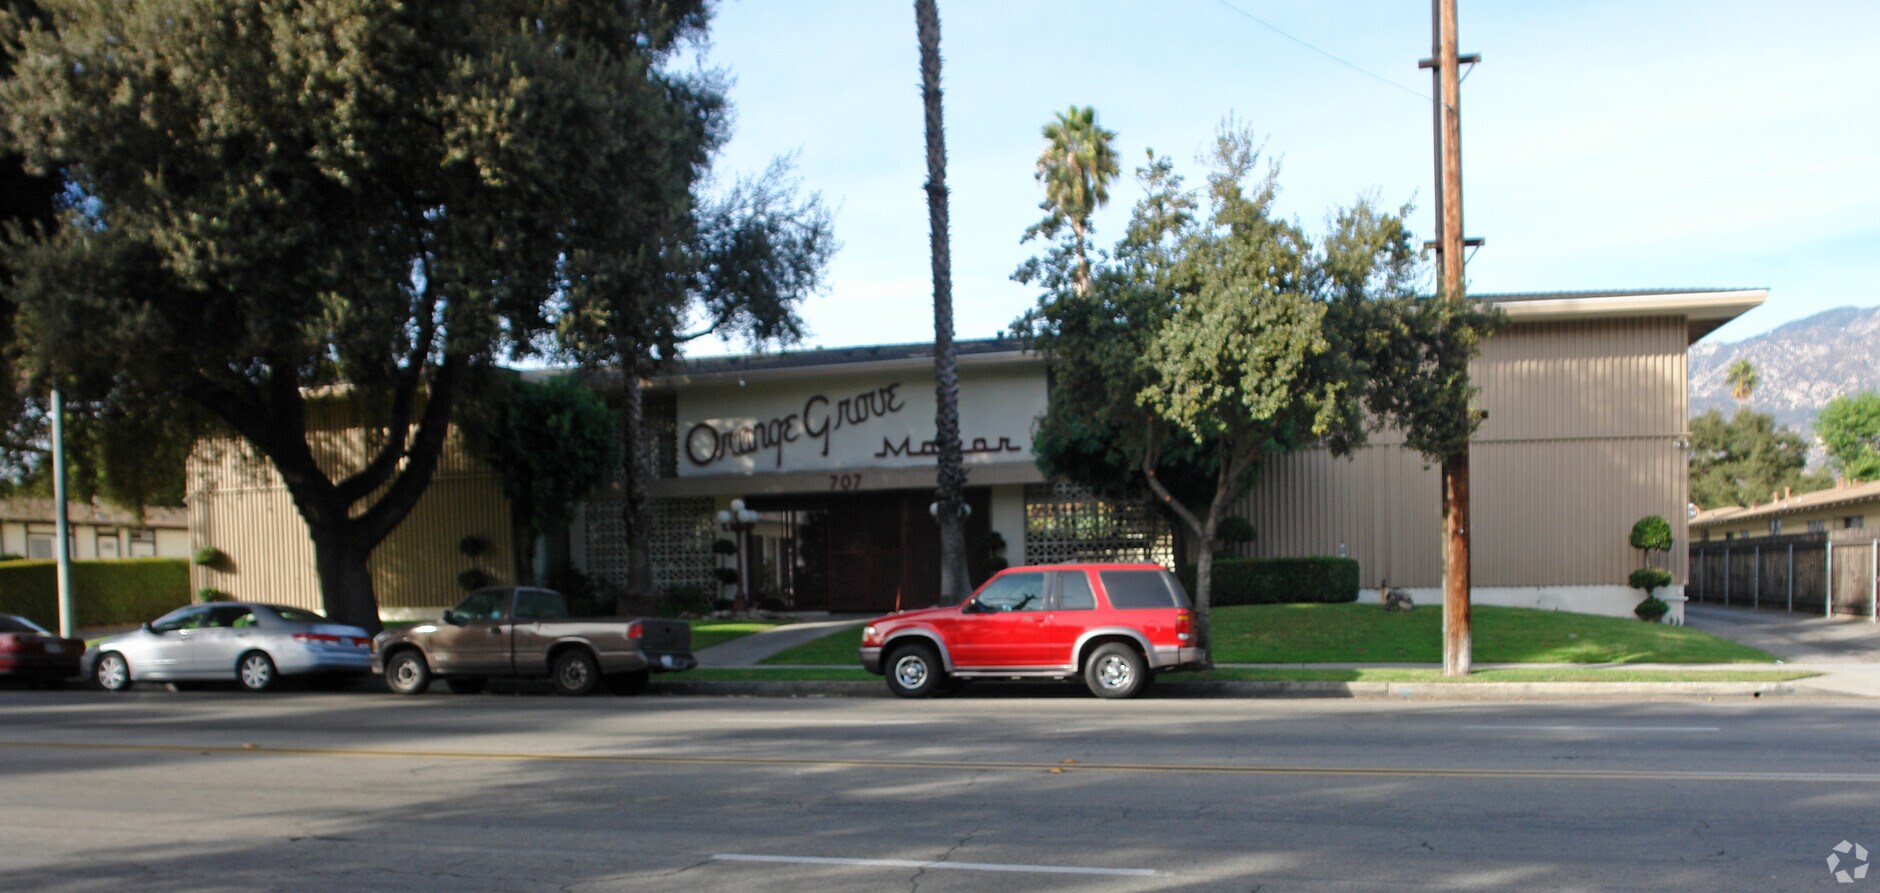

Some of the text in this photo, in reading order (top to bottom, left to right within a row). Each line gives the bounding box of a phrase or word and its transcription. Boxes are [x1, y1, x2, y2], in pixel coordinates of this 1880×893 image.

[685, 382, 906, 467] Orange Grove
[874, 434, 1022, 458] Maor
[829, 473, 863, 490] 707
